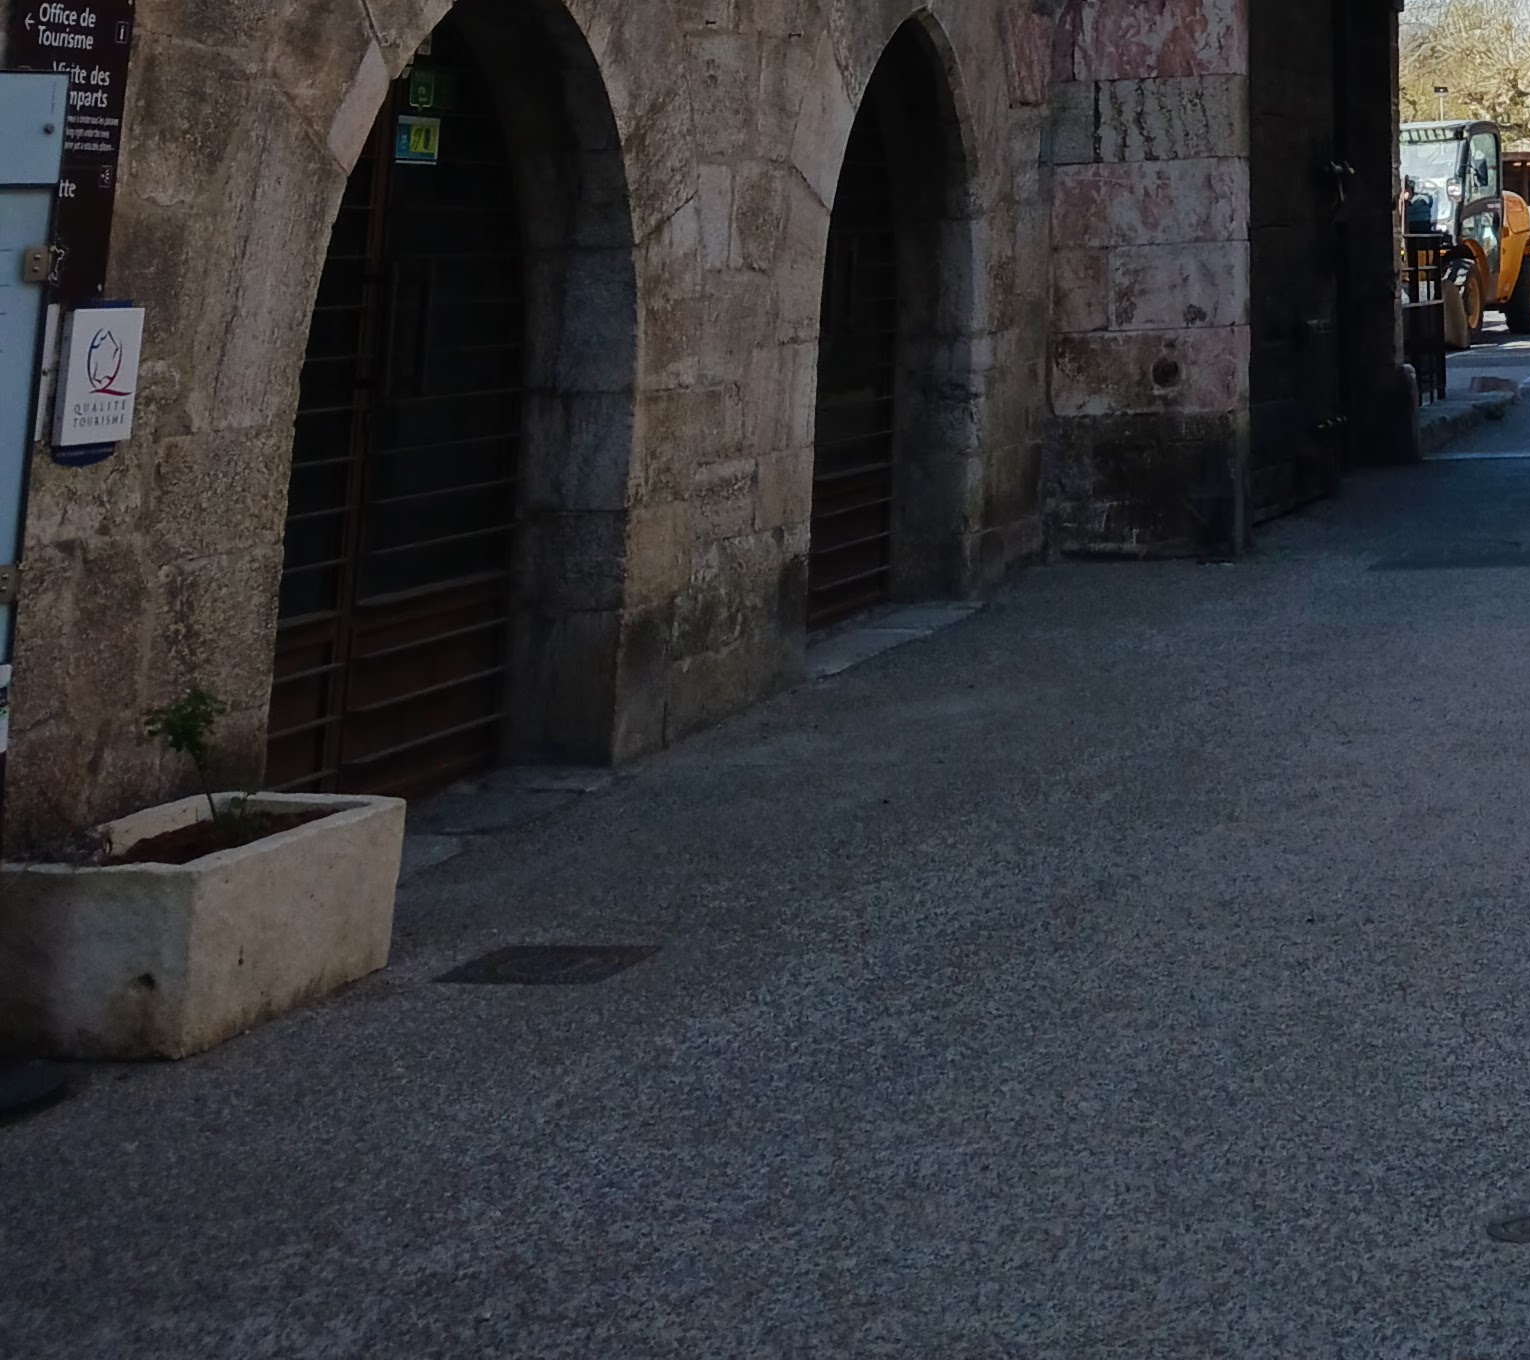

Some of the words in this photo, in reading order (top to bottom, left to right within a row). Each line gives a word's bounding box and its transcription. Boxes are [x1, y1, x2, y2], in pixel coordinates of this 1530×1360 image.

[39, 2, 78, 26] Office
[80, 7, 97, 28] de
[38, 26, 93, 49] Tourisme
[90, 64, 110, 86] des
[74, 414, 123, 427] TOURISME
